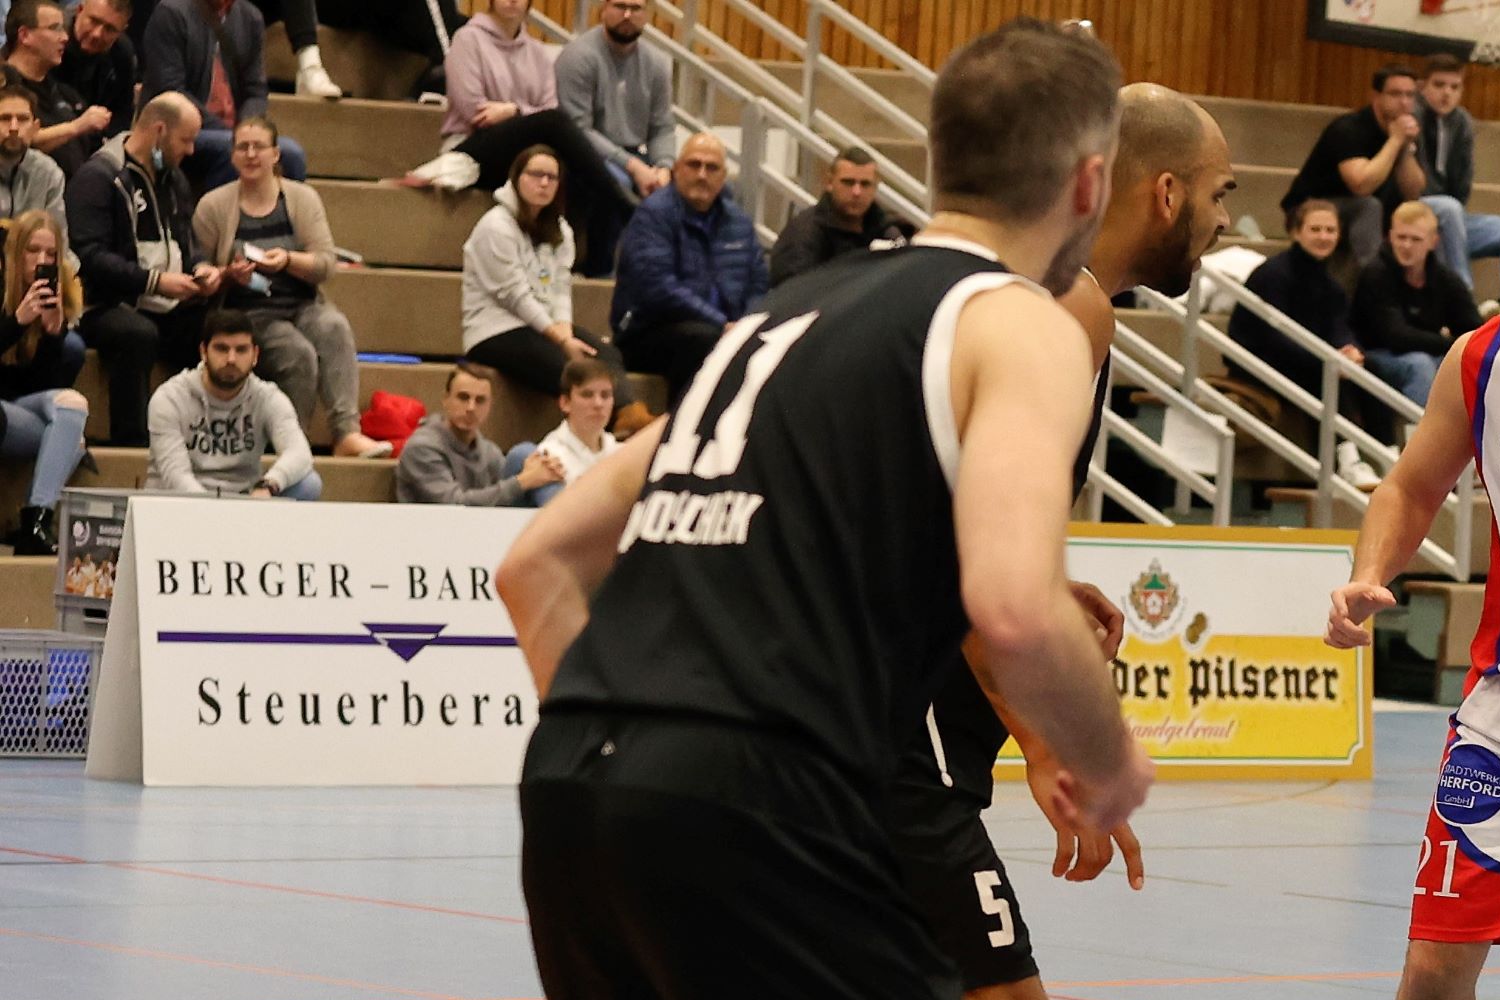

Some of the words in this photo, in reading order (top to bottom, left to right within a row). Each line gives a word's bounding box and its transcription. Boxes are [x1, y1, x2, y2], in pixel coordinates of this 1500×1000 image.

[648, 310, 820, 482] 11
[185, 433, 255, 454] JONES
[157, 560, 354, 598] BERGER
[408, 566, 495, 601] BAR
[198, 677, 524, 727] Steuerbera
[1113, 657, 1171, 699] der
[1188, 656, 1339, 706] Pilsener
[1444, 794, 1471, 806] GmbH
[1413, 835, 1460, 898] 21
[973, 869, 1016, 948] 5
